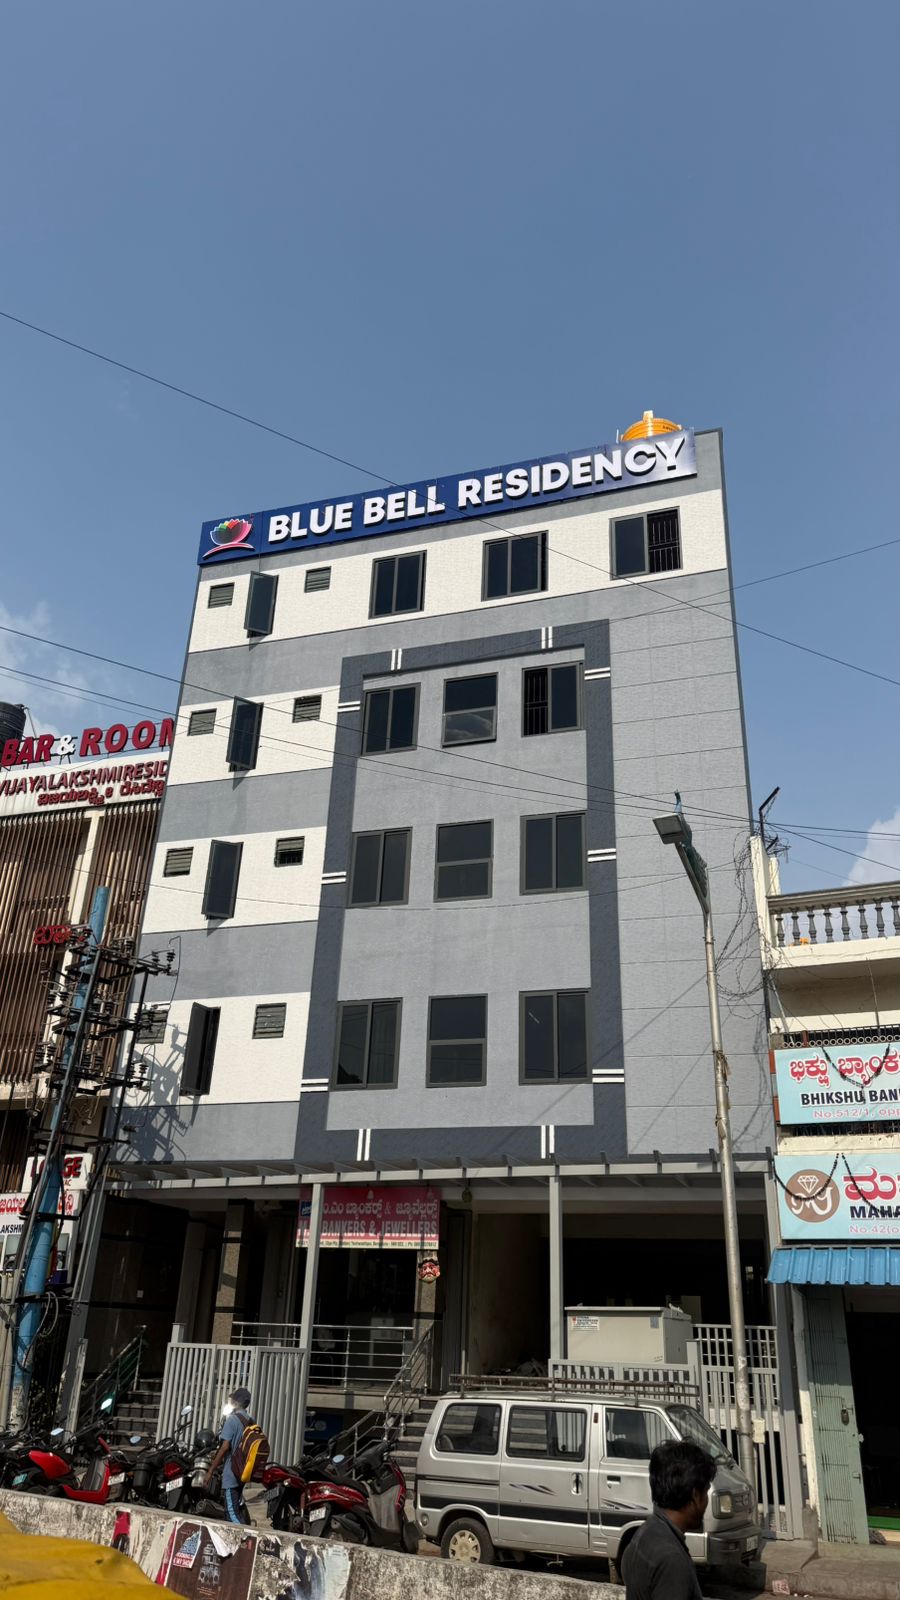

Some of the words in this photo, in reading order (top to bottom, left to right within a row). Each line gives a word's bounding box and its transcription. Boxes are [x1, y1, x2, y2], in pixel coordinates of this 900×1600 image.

[268, 502, 353, 544] BLUE
[363, 485, 447, 526] BELL
[458, 437, 686, 509] RESIDENCY
[0, 734, 54, 767] BAR
[56, 734, 76, 757] &
[838, 1052, 900, 1086] ಬ್ಯಾಂಕ
[801, 1090, 865, 1106] BHIKSHU
[869, 1088, 900, 1103] BAN
[322, 1221, 366, 1237] BANKERS
[369, 1221, 377, 1237] &
[377, 1221, 438, 1238] JEWELLERS
